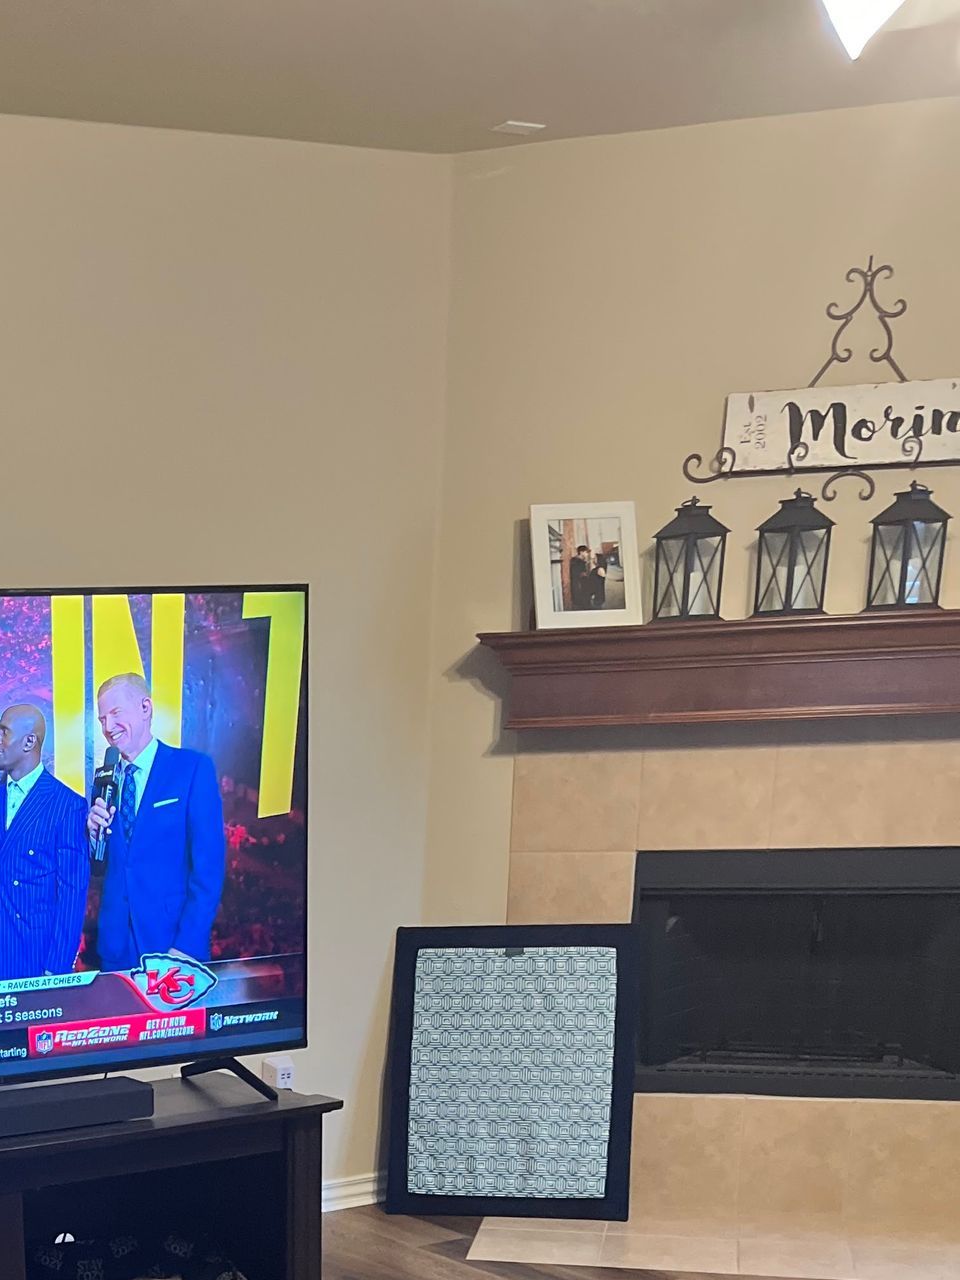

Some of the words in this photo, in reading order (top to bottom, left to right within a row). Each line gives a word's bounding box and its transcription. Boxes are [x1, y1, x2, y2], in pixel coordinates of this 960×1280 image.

[8, 979, 40, 990] RAVENS
[41, 978, 52, 986] AT
[53, 976, 82, 985] CHIEFS
[5, 1010, 13, 1023] 5
[15, 1008, 63, 1021] seasons
[146, 1018, 161, 1030] GET
[169, 1015, 187, 1027] NOW
[223, 1010, 279, 1026] NETWORK
[88, 1034, 129, 1046] NETWORK
